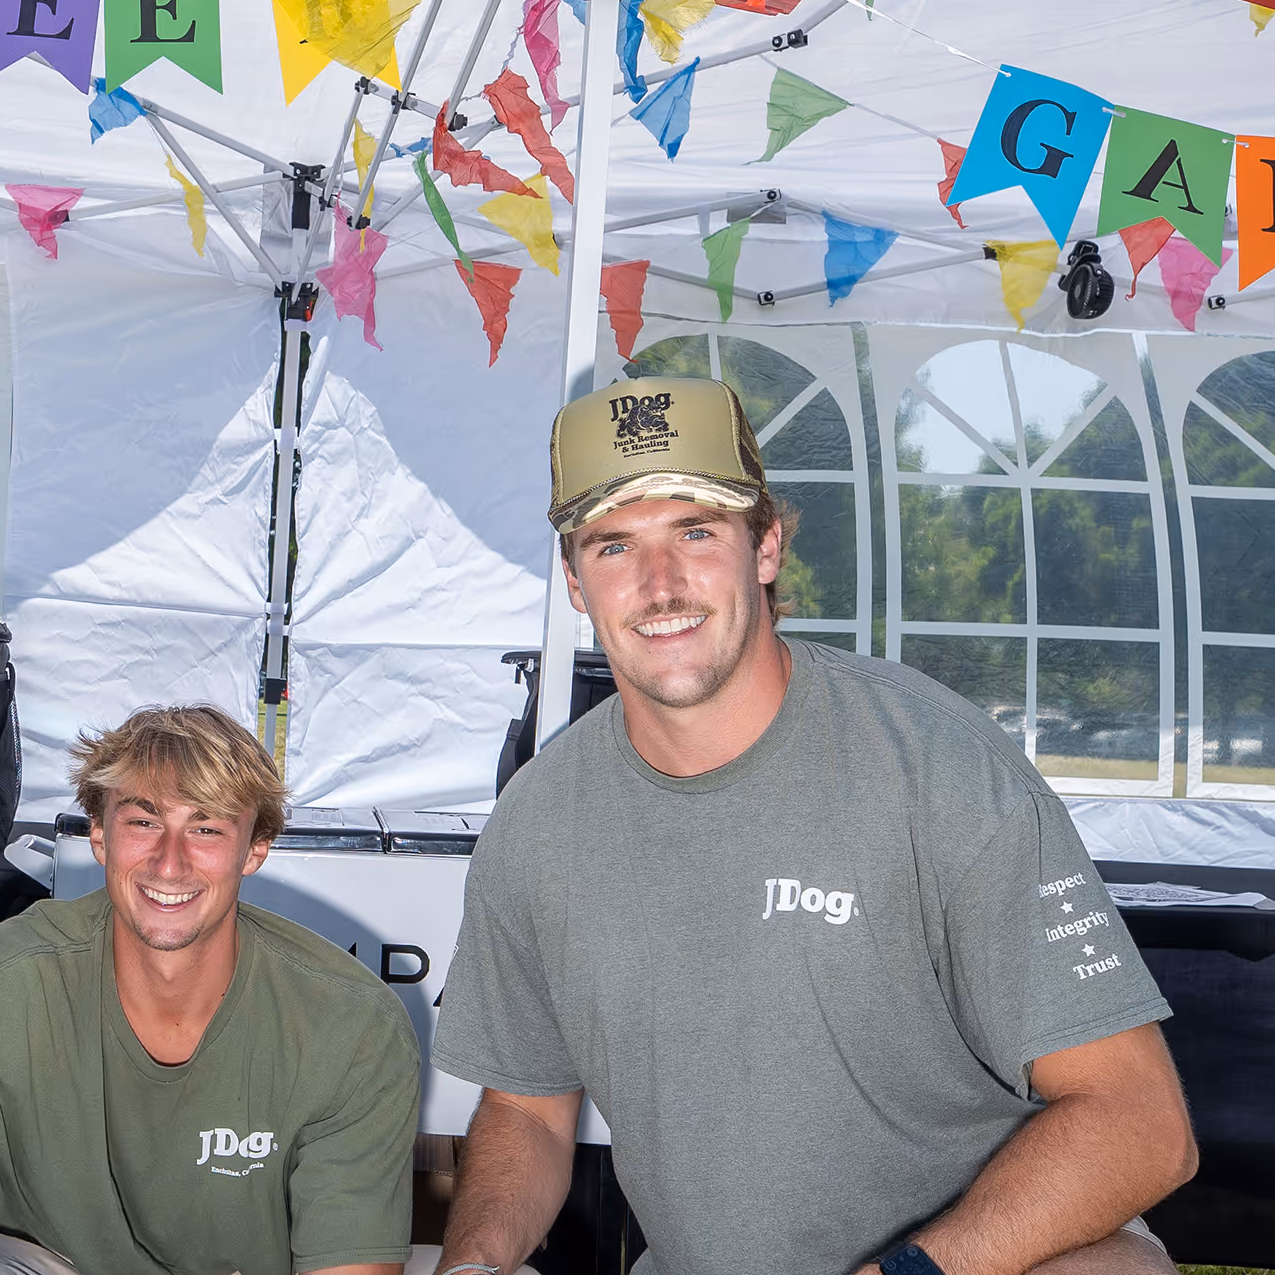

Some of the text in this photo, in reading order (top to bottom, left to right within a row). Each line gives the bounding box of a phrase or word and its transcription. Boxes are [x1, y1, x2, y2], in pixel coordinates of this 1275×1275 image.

[1000, 99, 1275, 233] GA
[613, 430, 679, 450] Junk Removal
[631, 439, 669, 451] Hauling
[1045, 911, 1109, 942] Integrity
[1072, 953, 1122, 980] Trust
